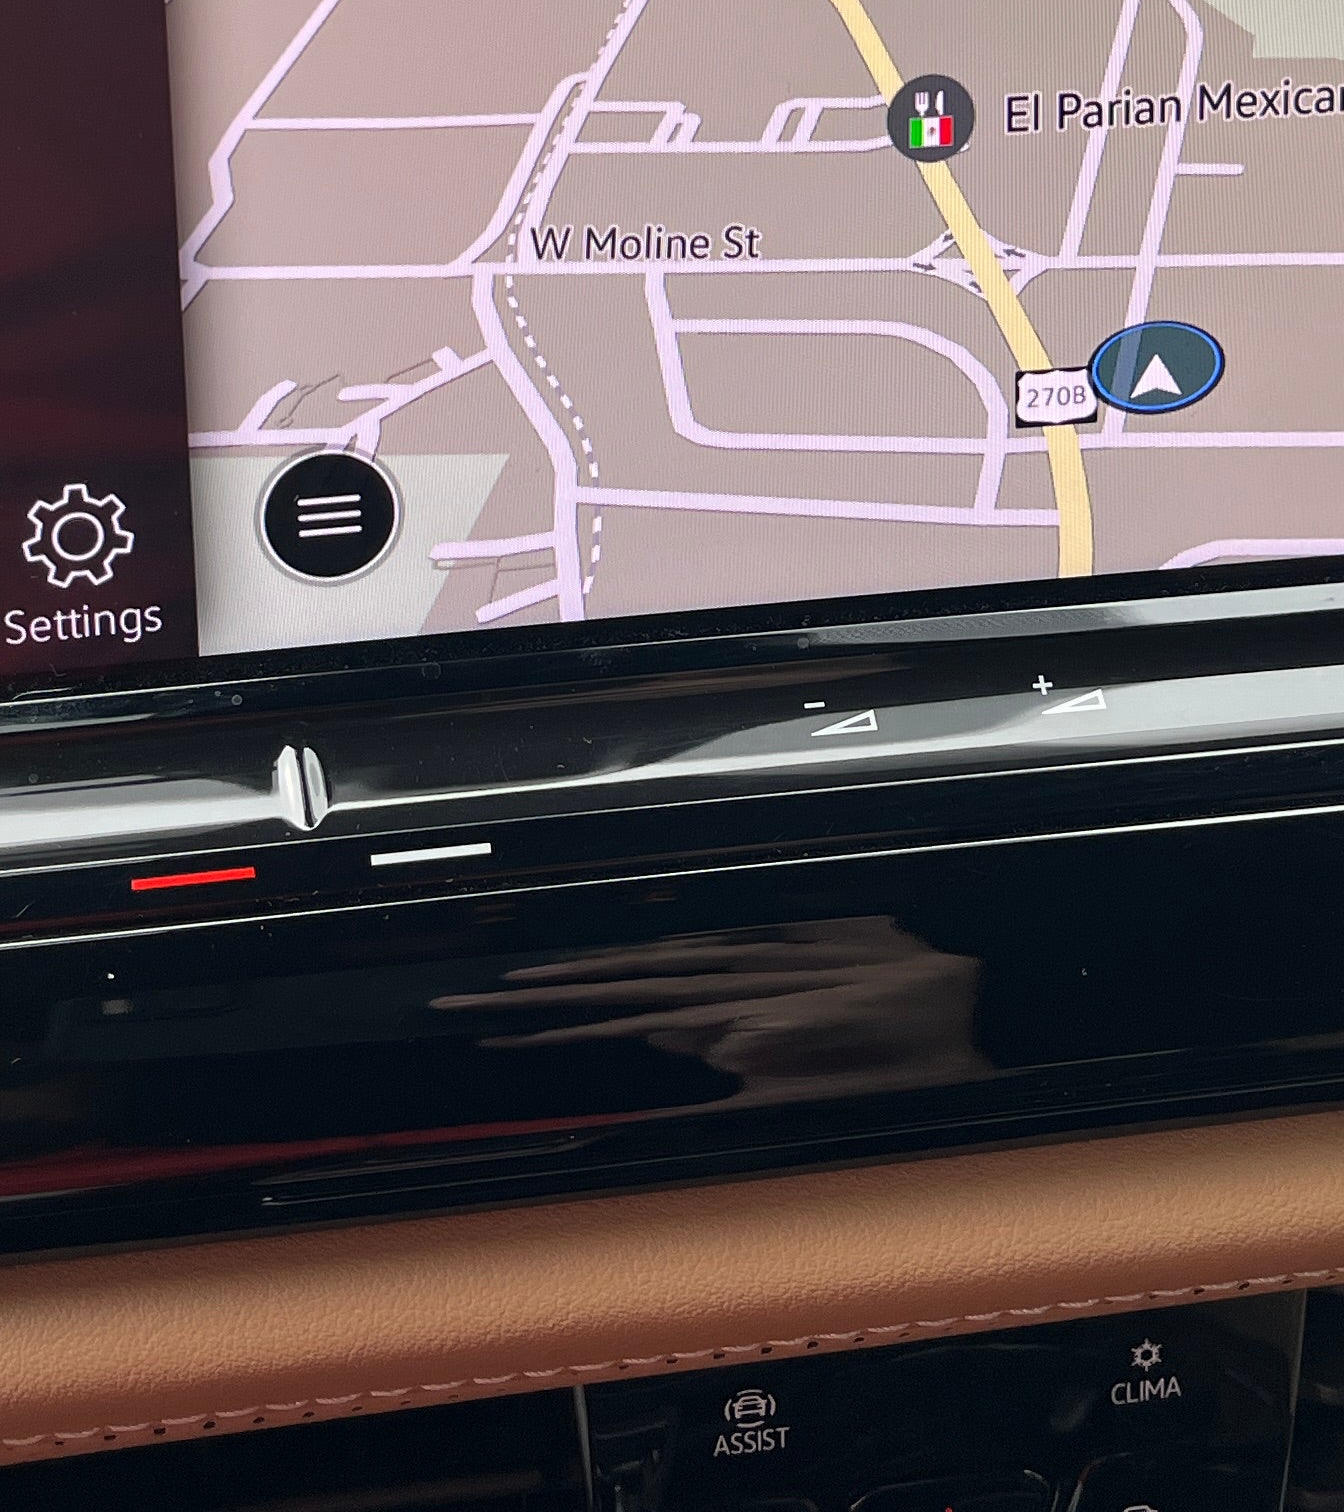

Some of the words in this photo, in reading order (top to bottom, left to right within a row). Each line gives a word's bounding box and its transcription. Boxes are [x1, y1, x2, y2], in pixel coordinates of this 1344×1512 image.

[1005, 94, 1042, 134] El
[1057, 86, 1183, 129] Parian
[530, 228, 572, 259] W
[585, 226, 711, 259] Moline
[723, 225, 760, 258] St
[1025, 384, 1088, 409] 270B
[2, 603, 163, 646] Settings
[1111, 1376, 1181, 1406] CLIMA
[713, 1426, 790, 1456] ASSIST
